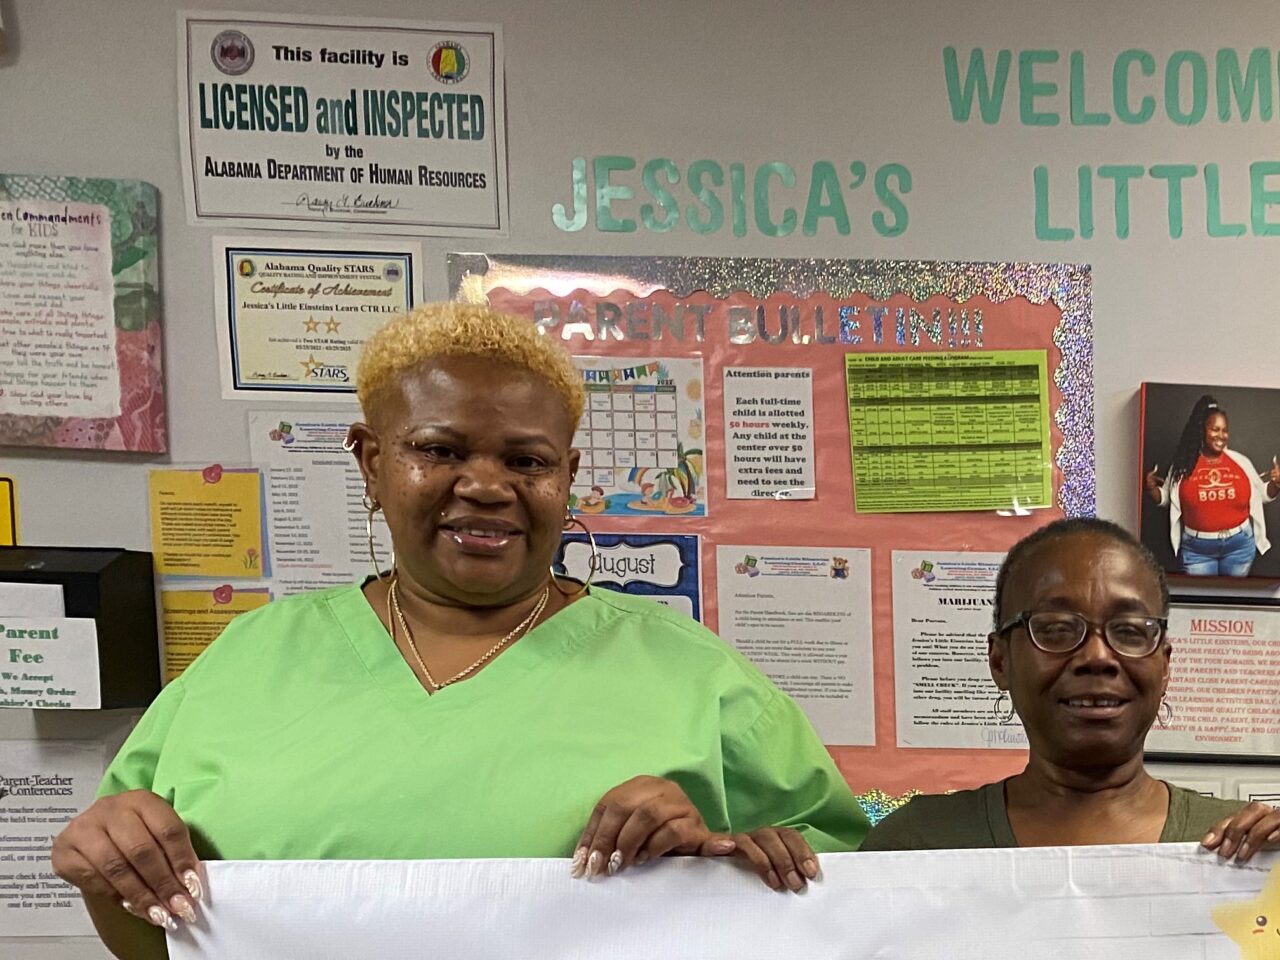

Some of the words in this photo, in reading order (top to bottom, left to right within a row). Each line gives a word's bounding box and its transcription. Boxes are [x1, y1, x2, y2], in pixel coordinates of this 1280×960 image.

[272, 45, 312, 62] This
[319, 48, 384, 69] facility
[392, 51, 409, 67] is
[198, 82, 309, 133] LICENSED
[316, 89, 358, 136] and
[363, 90, 485, 141] INSPECTED
[325, 144, 340, 160] by
[344, 146, 364, 159] the
[204, 156, 262, 179] ALABAMA
[267, 158, 345, 183] DEPARTMENT
[350, 167, 364, 183] OF
[369, 168, 413, 186] HUMAN
[419, 170, 487, 189] RESOURCES
[552, 155, 912, 238] JESSICA'S
[0, 212, 13, 221] en
[29, 222, 58, 237] KIDS
[264, 262, 305, 272] Alabama
[308, 263, 342, 275] Quality
[344, 264, 375, 273] STARS
[250, 281, 305, 298] Certificate
[307, 283, 321, 299] of
[322, 283, 393, 297] Achievement
[242, 301, 275, 310] Jessica's
[276, 302, 297, 310] Little
[299, 303, 333, 311] Einsteins
[335, 304, 358, 312] Learn
[360, 304, 379, 312] CTR
[381, 305, 400, 313] LLC
[534, 300, 711, 343] PARENT
[311, 367, 348, 379] STARS
[725, 369, 772, 378] Attention
[774, 371, 810, 380] parents
[736, 397, 758, 405] Each
[760, 397, 801, 406] full-time
[732, 409, 756, 417] child
[768, 409, 805, 417] allotted
[742, 420, 770, 428] hours
[772, 421, 808, 430] weekly.
[732, 432, 751, 440] Any
[754, 432, 777, 440] child
[791, 432, 807, 440] the
[734, 455, 761, 463] hours
[763, 455, 782, 463] will
[761, 478, 771, 486] to
[790, 478, 805, 486] the
[1199, 488, 1236, 501] BOSS
[938, 598, 992, 606] MARIJUAN
[1190, 619, 1255, 634] MISSION
[8, 648, 44, 664] Fee
[1, 672, 19, 681] We
[21, 673, 54, 684] Accept
[10, 687, 43, 697] Money
[46, 687, 77, 696] Order
[9, 786, 73, 796] Conferences
